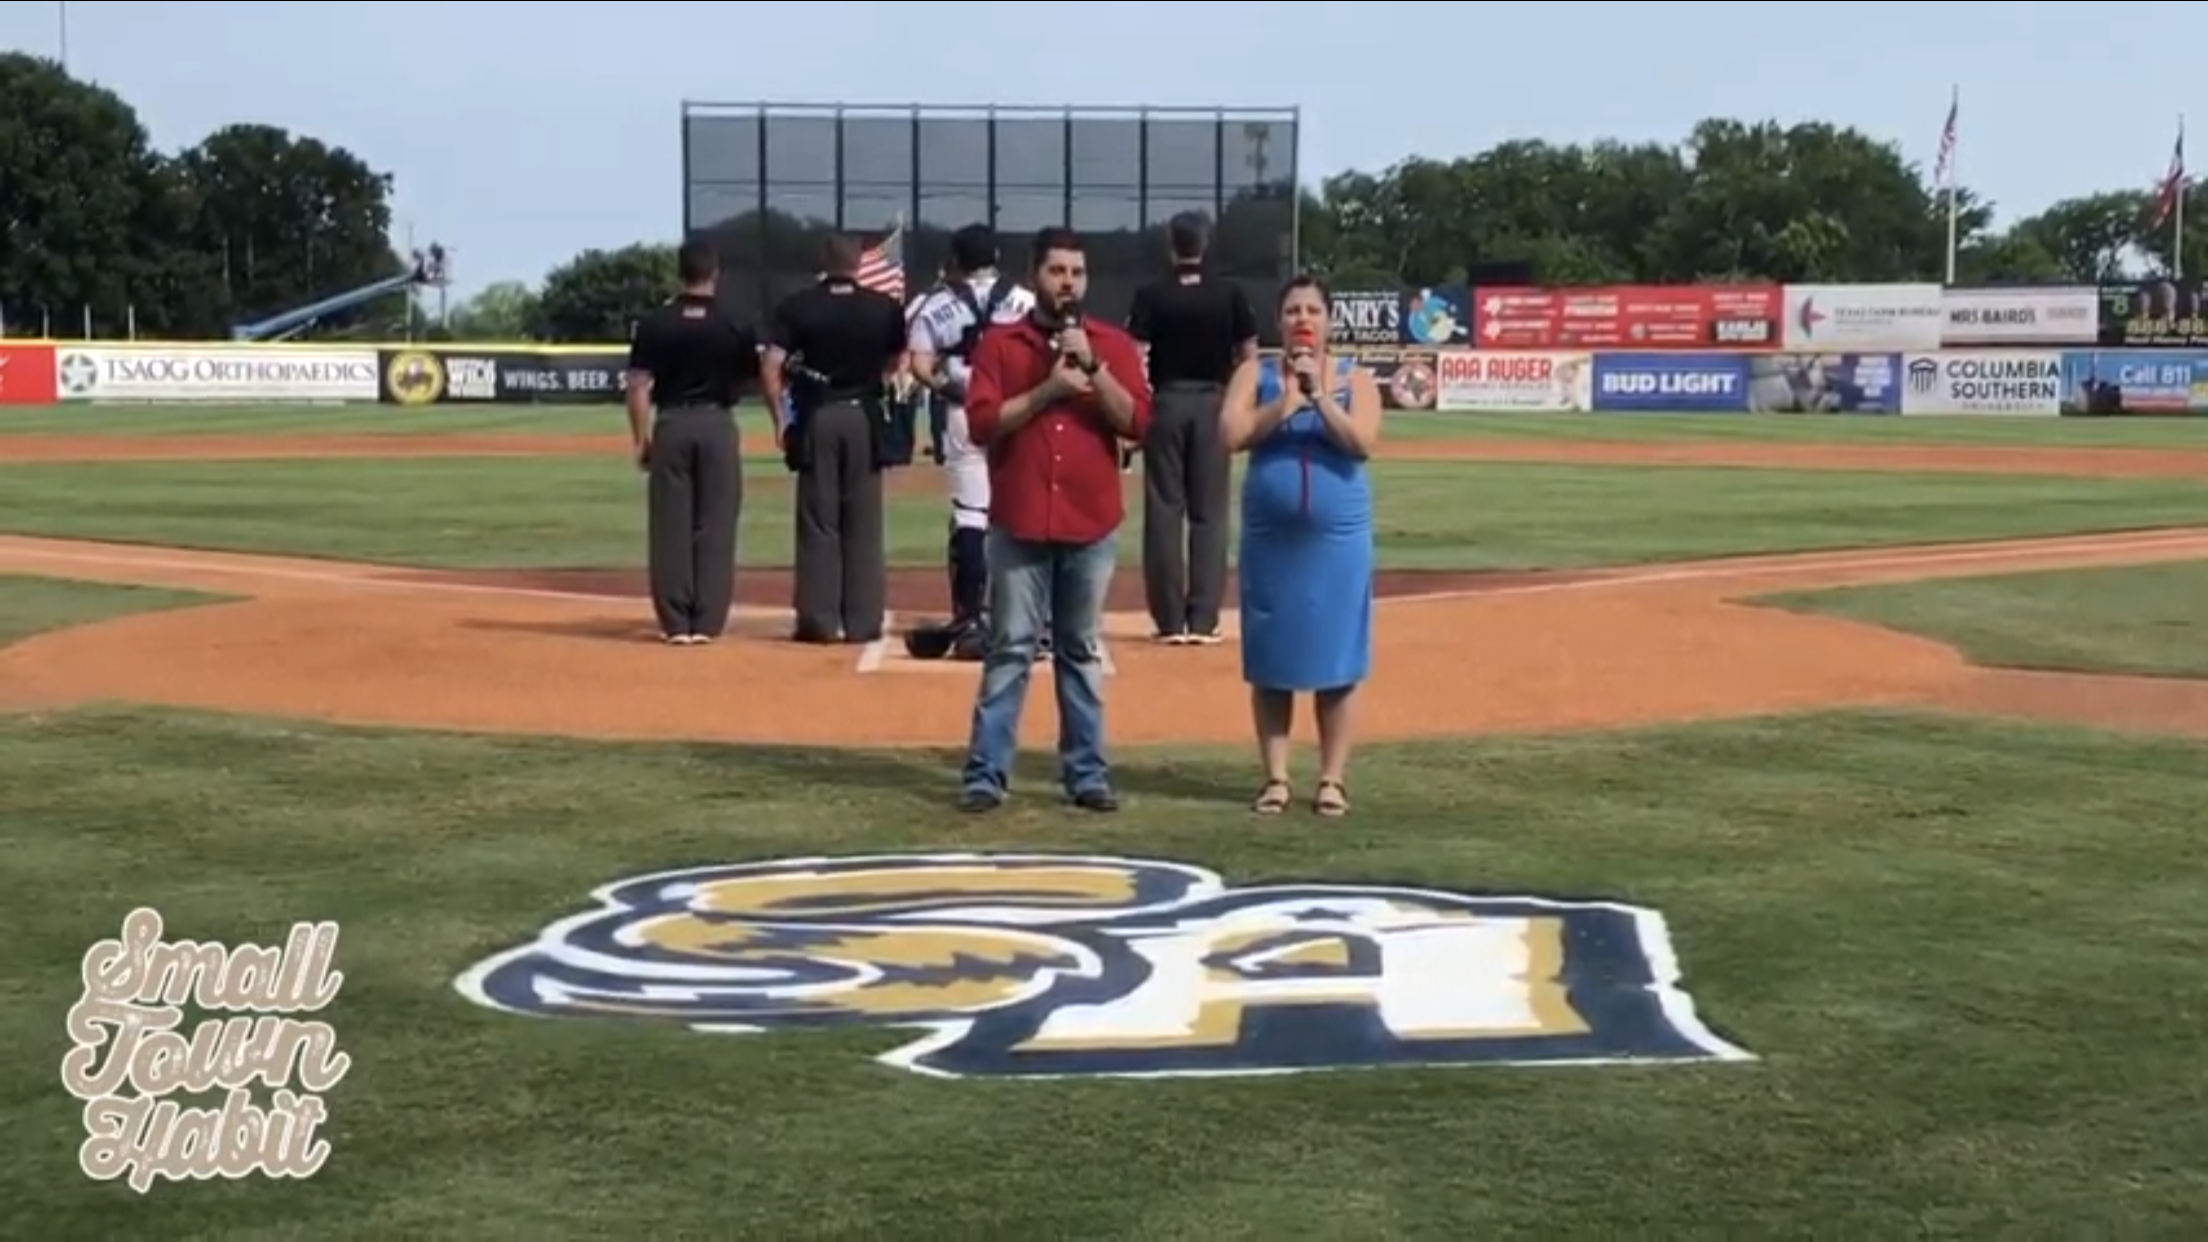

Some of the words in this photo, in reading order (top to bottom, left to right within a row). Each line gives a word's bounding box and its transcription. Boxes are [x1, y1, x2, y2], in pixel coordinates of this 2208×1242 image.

[1951, 308, 1979, 324] MRS
[106, 358, 190, 382] TSAOG
[193, 358, 376, 382] ORTHOPAEDICS
[1442, 357, 1482, 380] AAA
[1487, 357, 1553, 381] AUGER
[1946, 359, 2060, 379] COLUMBIA
[2120, 362, 2158, 385] Call
[2161, 363, 2191, 385] 811
[1602, 371, 1657, 394] BUD
[1660, 371, 1737, 394] LIGHT
[1950, 381, 2057, 400] SOUTHERN
[455, 853, 1757, 1080] SA
